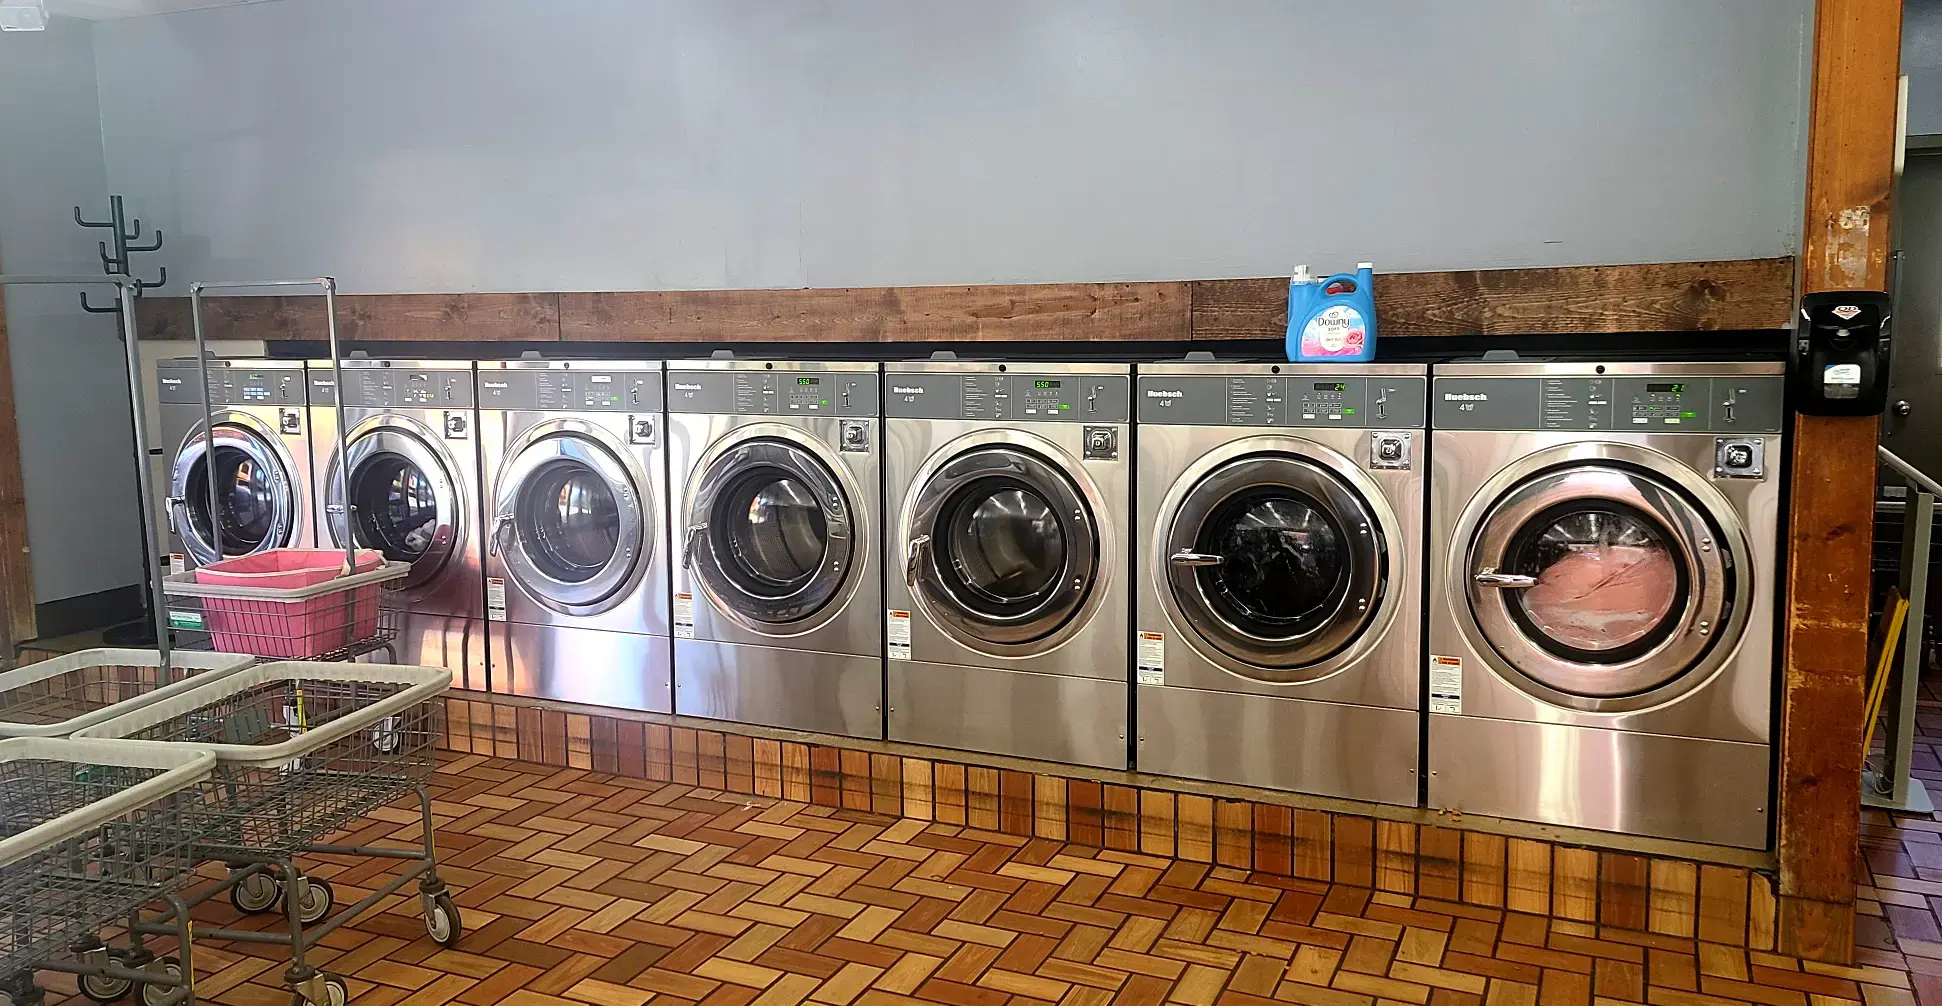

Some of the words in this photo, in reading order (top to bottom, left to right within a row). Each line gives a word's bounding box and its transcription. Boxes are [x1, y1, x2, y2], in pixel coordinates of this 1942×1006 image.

[1318, 317, 1350, 328] Downy
[1334, 383, 1346, 391] 24
[1147, 390, 1183, 398] Huebsch
[1444, 393, 1487, 401] Huebsch
